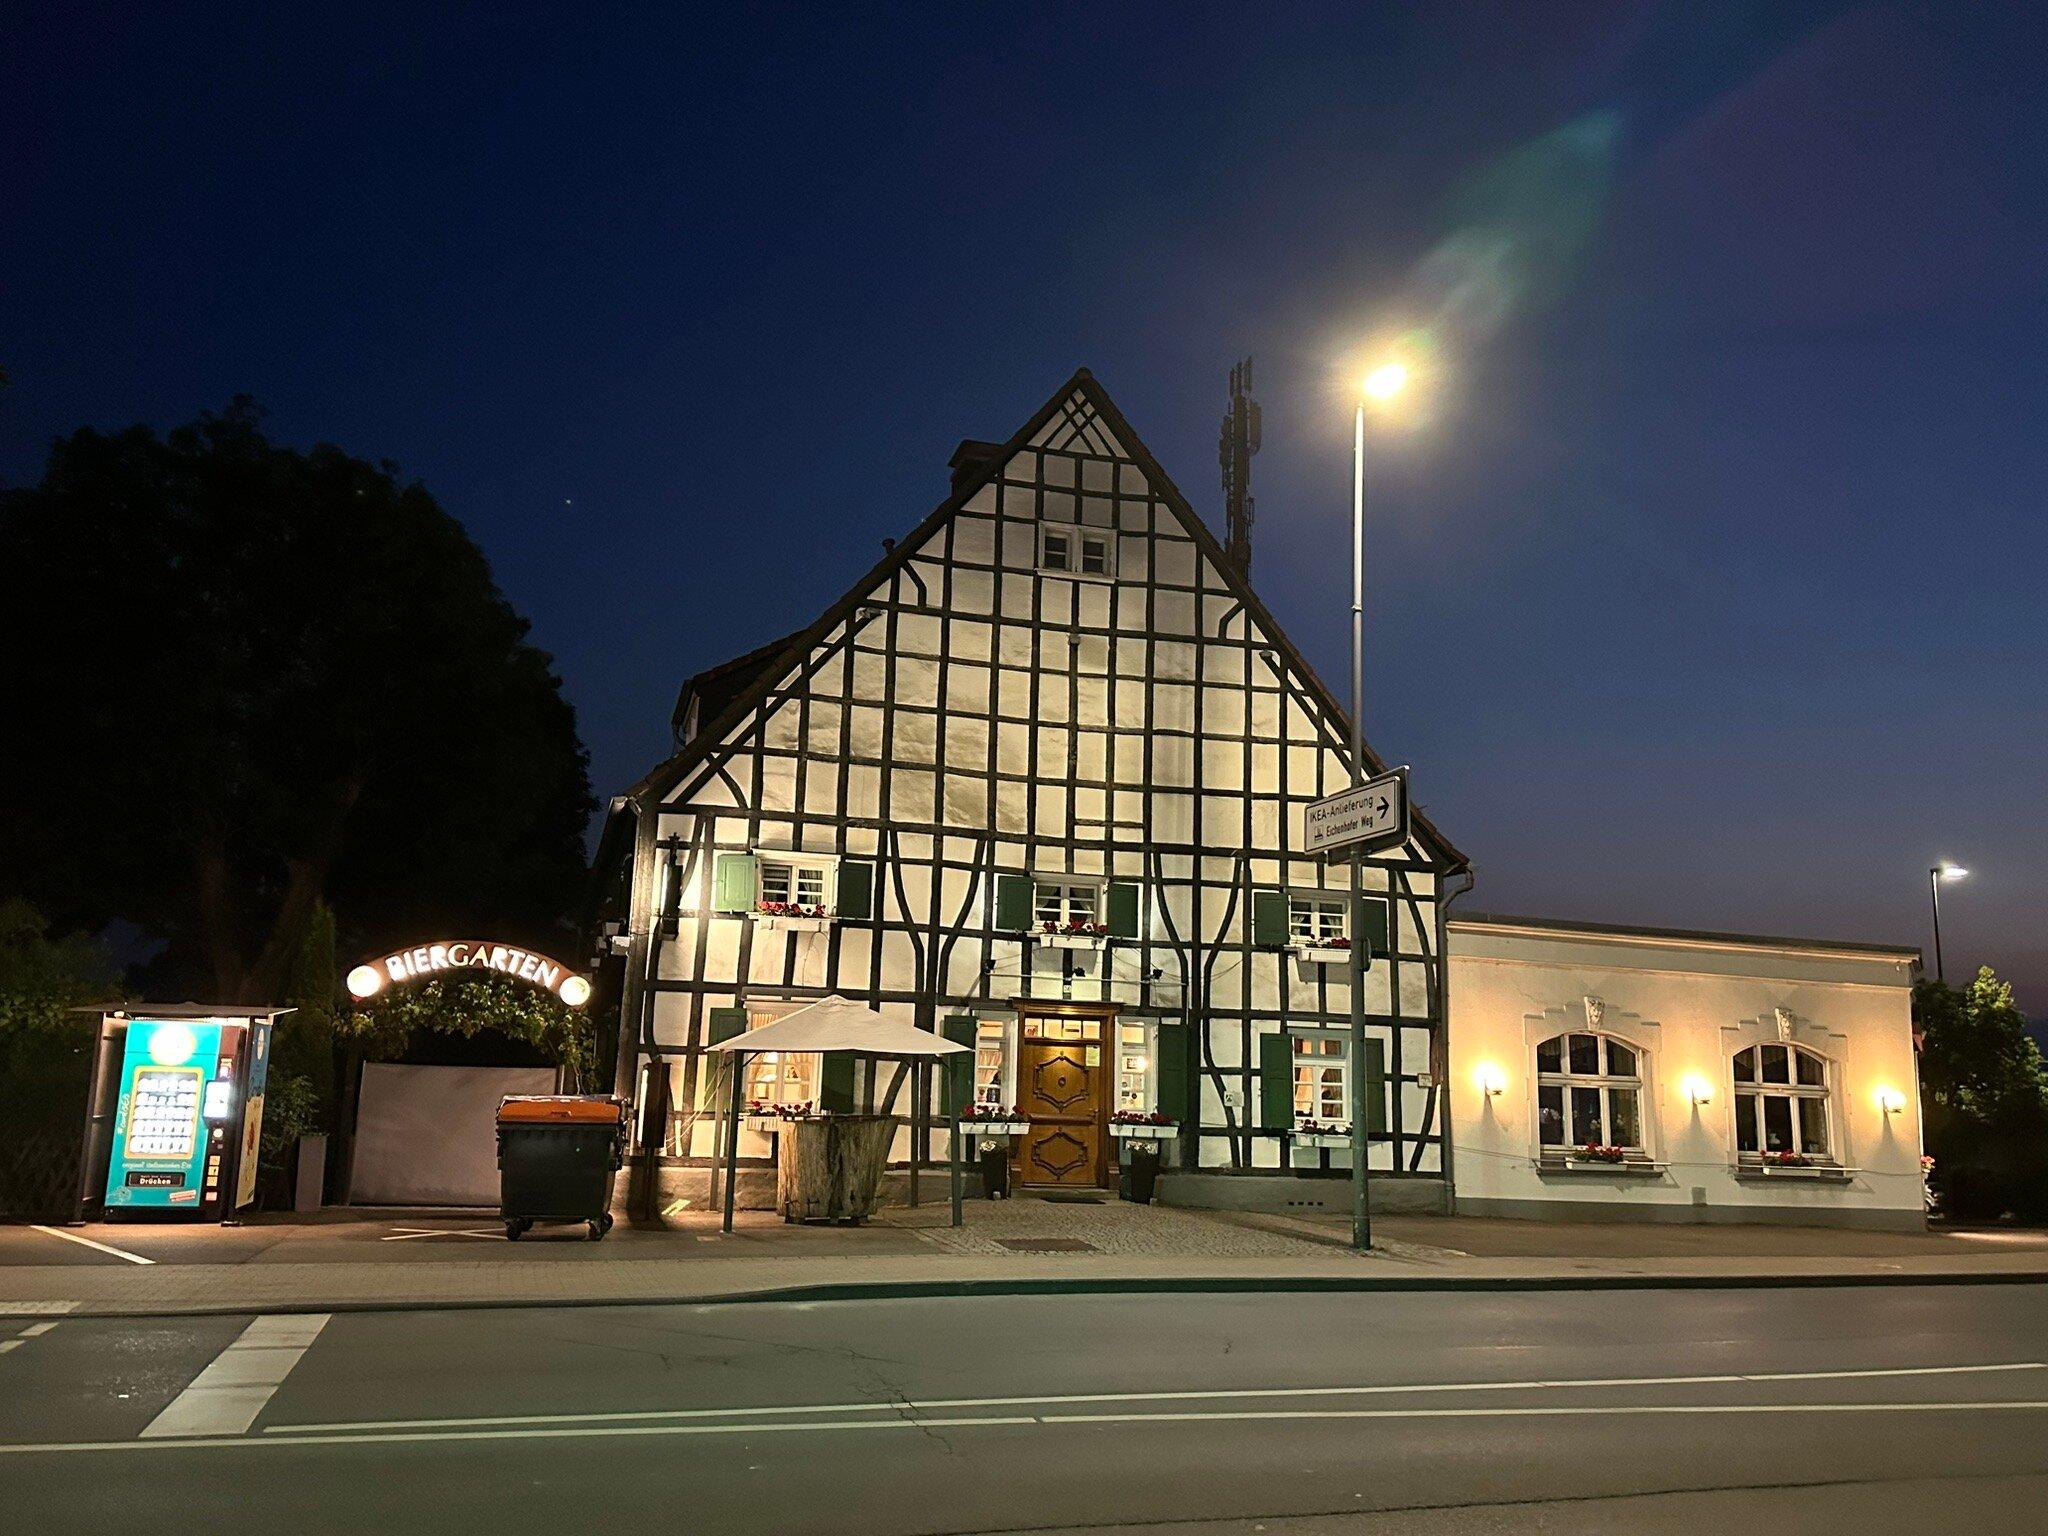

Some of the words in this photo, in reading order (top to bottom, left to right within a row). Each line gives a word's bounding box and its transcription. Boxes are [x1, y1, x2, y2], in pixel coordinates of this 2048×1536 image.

[1310, 796, 1373, 823] IKEA-Anlieferung
[1361, 815, 1373, 828] Weg
[385, 944, 560, 988] BIERGARTEN
